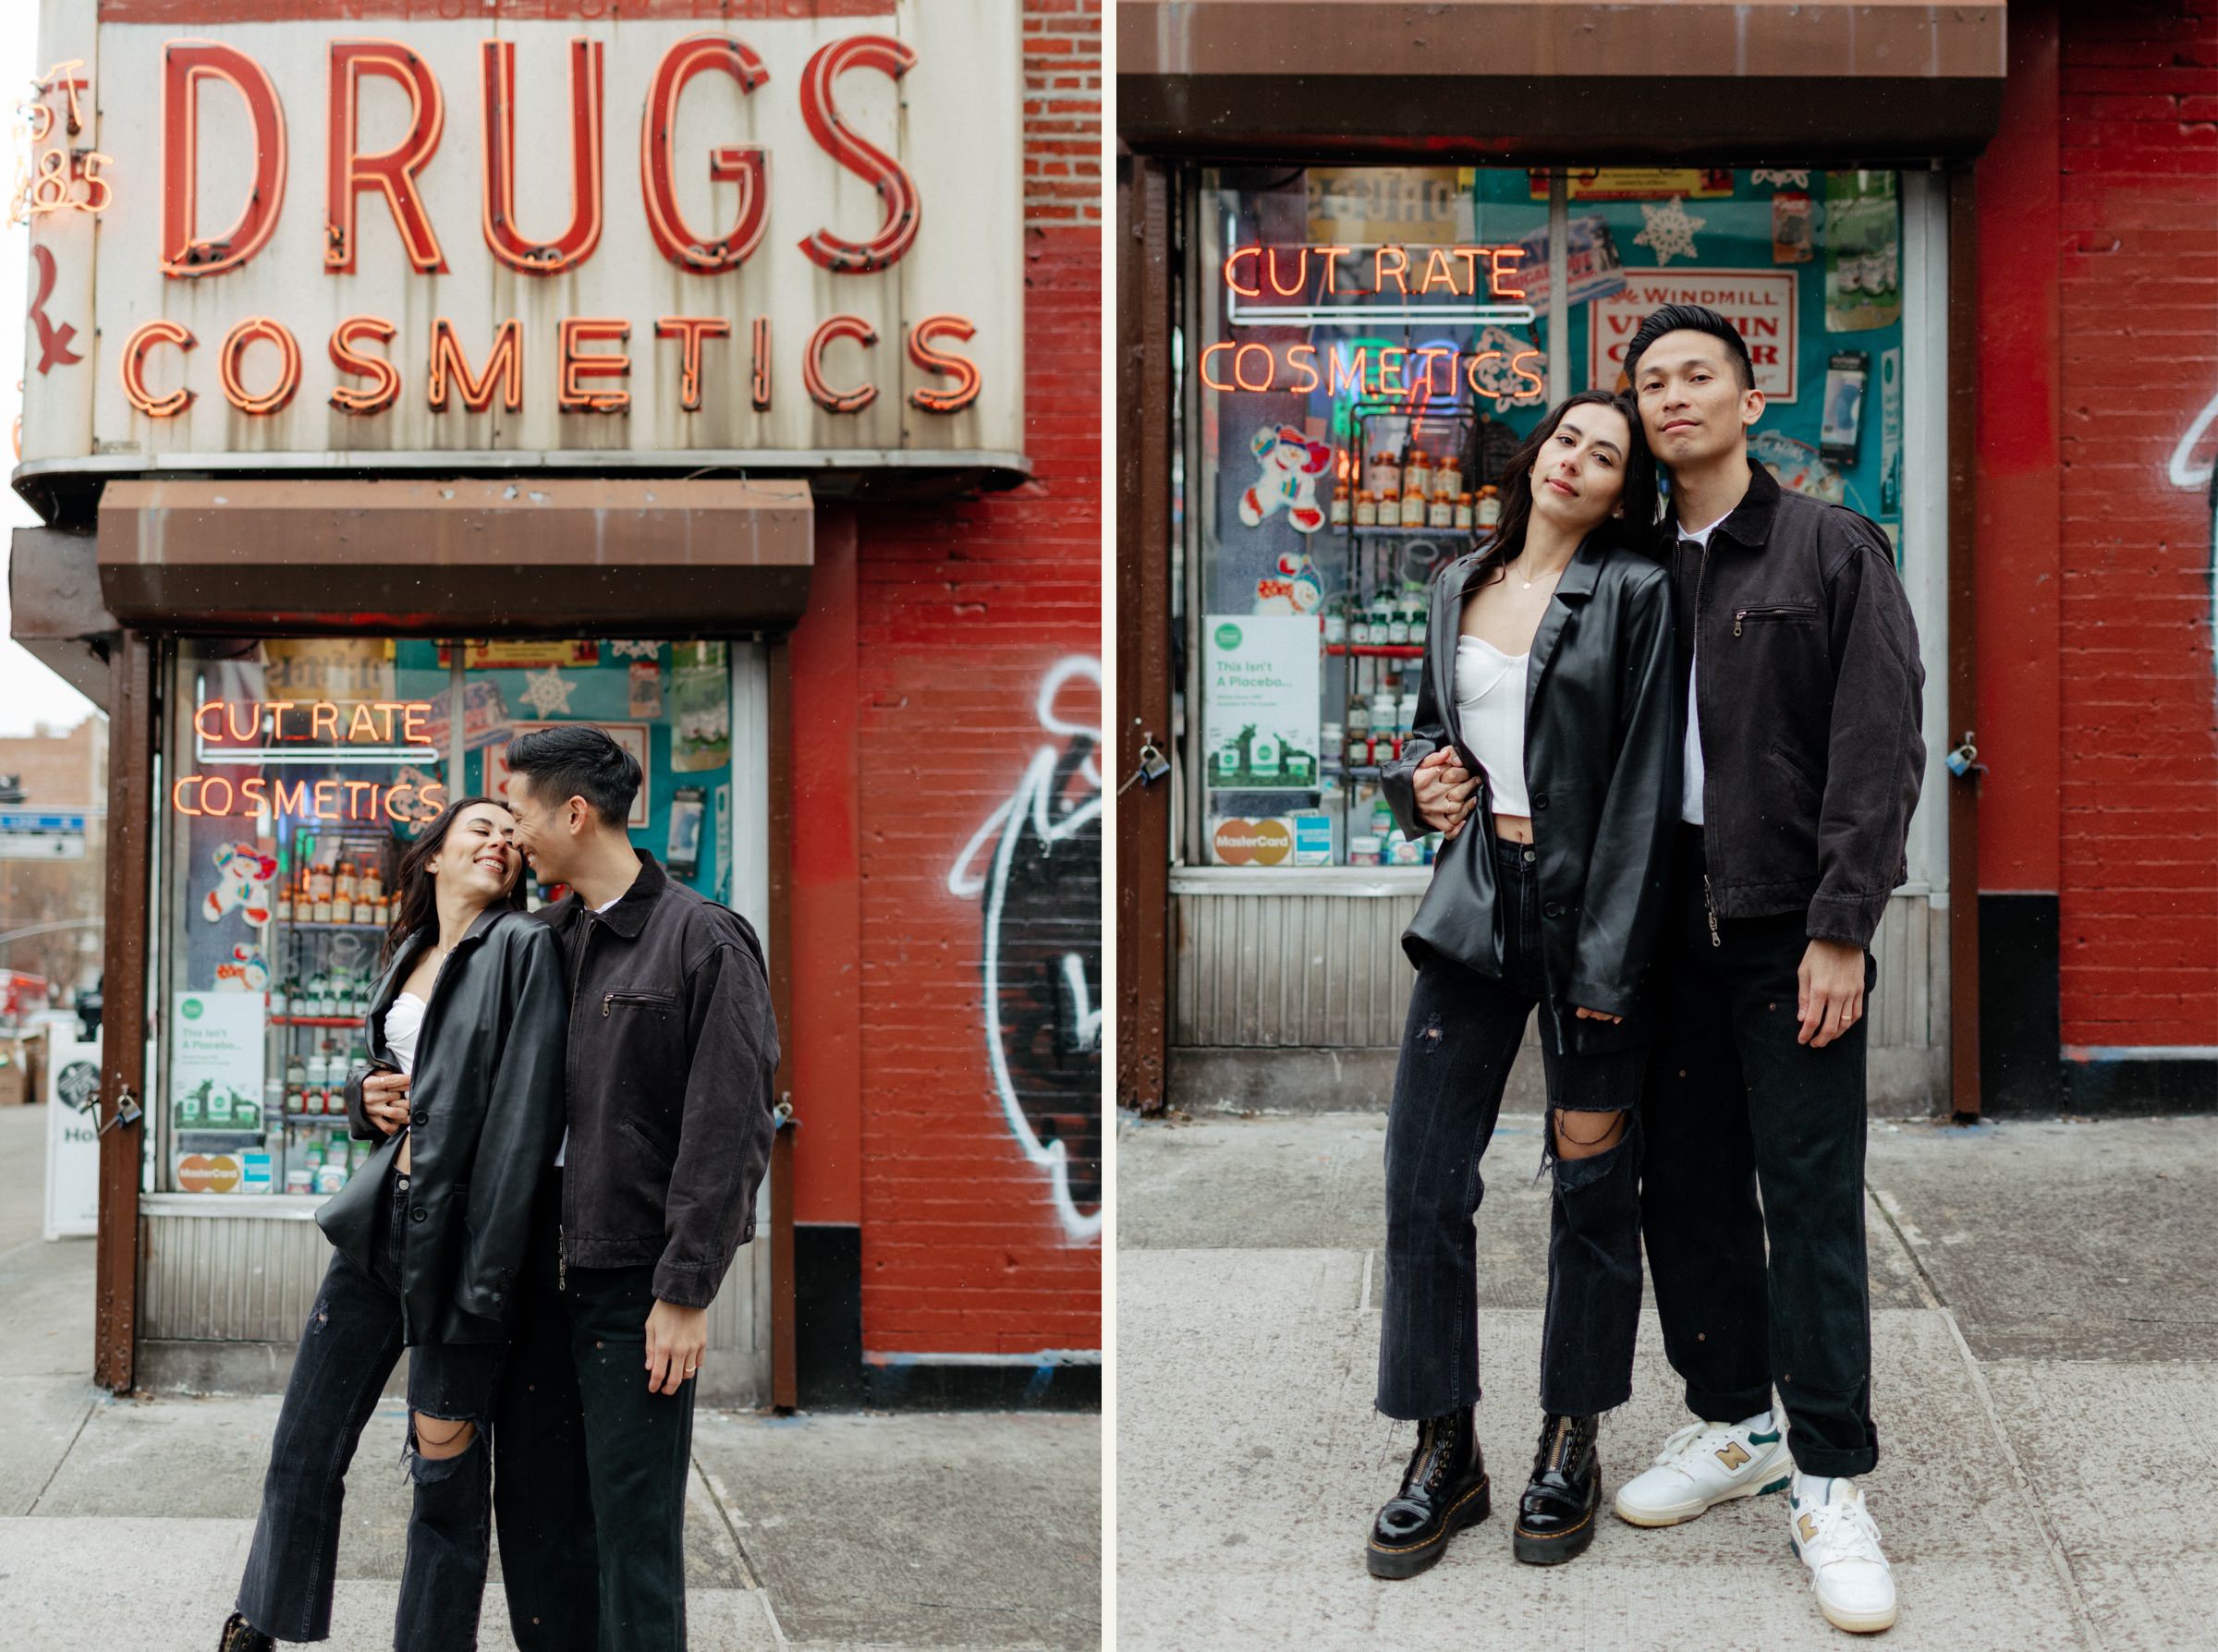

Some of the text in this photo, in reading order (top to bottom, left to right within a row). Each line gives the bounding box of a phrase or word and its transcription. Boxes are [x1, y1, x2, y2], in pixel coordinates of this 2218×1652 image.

[158, 32, 921, 279] DRUGS
[1225, 248, 1351, 298] CUT
[1375, 248, 1527, 298] RATE
[1644, 287, 1779, 306] WINDMILL
[120, 314, 981, 416] COSMETICS
[1200, 340, 1544, 398] COSMETICS
[1216, 661, 1273, 672] This Isn't
[1216, 677, 1225, 687] A
[194, 699, 295, 743] CUT
[311, 701, 433, 744] RATE
[173, 775, 445, 822] COSMETICS
[1215, 834, 1289, 848] MasterCard
[182, 1028, 202, 1038] This
